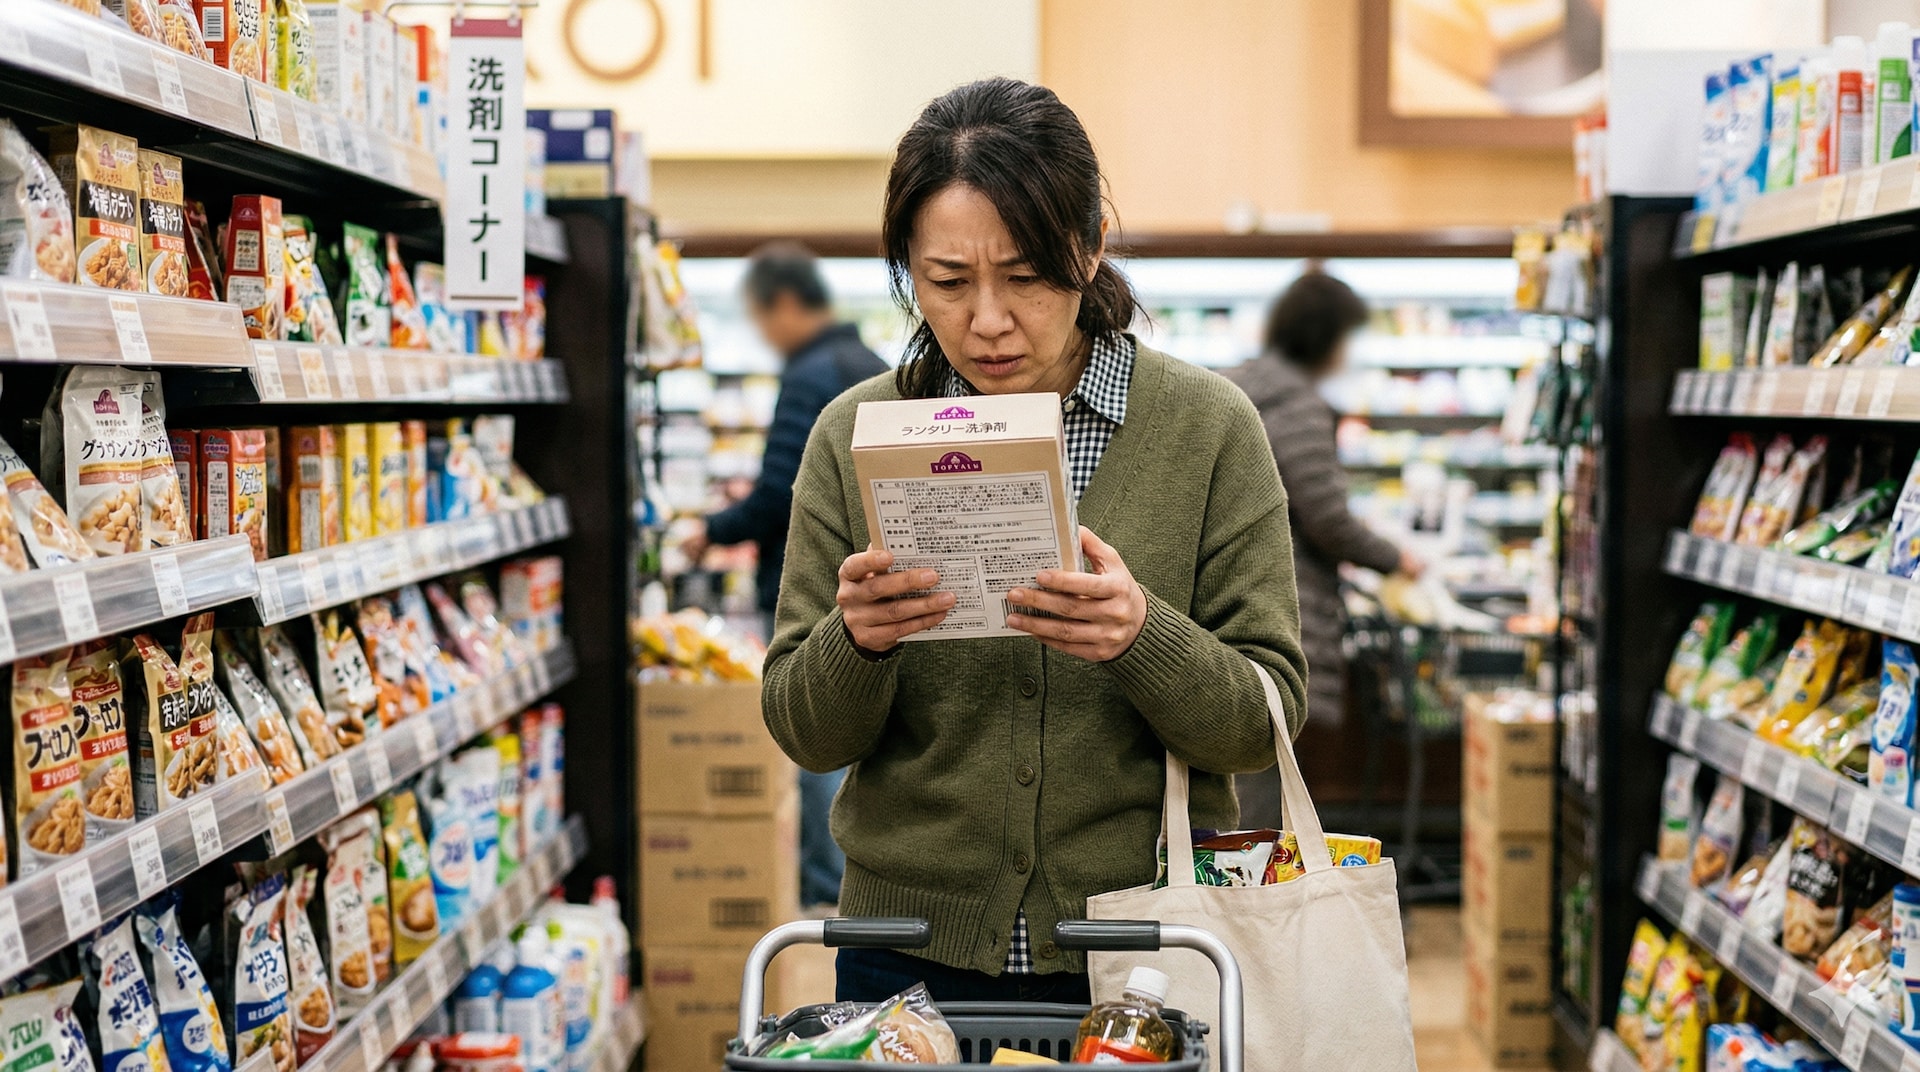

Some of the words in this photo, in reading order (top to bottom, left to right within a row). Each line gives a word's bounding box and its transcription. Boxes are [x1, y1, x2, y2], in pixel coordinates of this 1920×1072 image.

[468, 57, 504, 282] 洗剤コーナー
